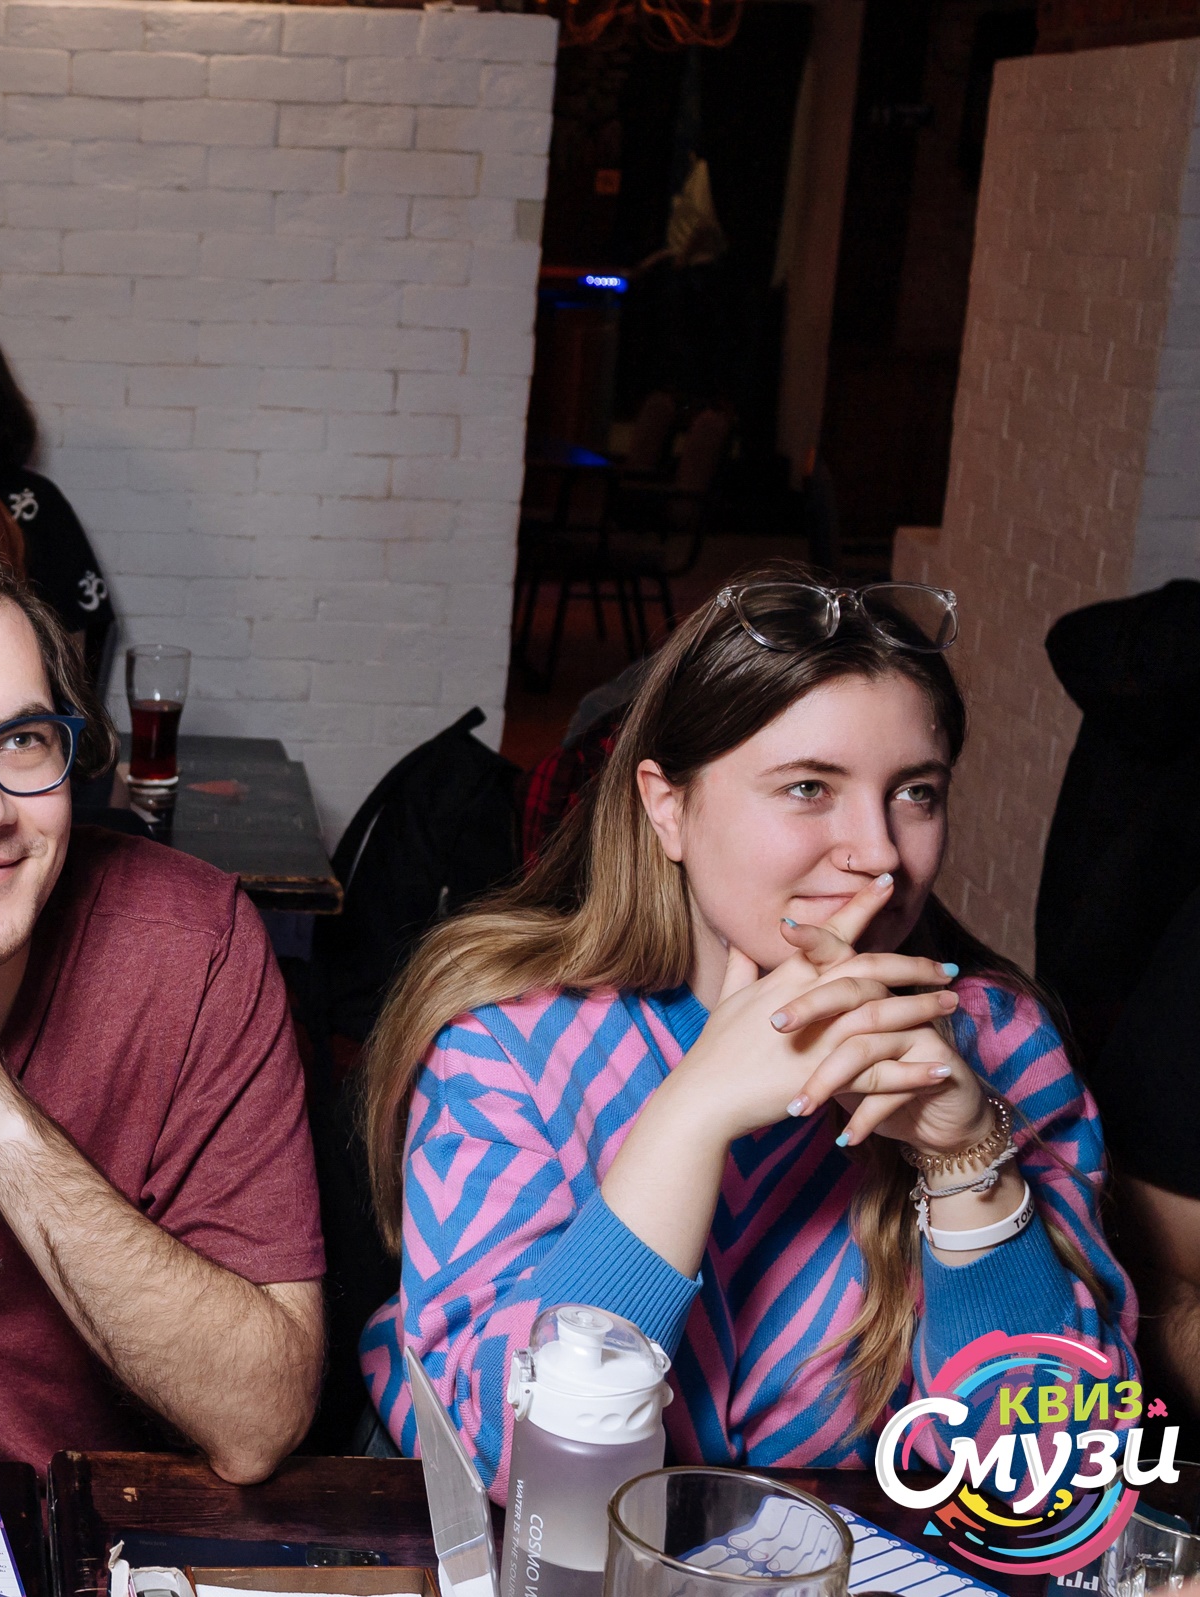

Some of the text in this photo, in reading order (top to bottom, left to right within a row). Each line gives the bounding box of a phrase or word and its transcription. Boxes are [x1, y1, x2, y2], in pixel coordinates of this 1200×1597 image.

[514, 1479, 524, 1520] WATER
[513, 1520, 520, 1534] IS
[511, 1536, 519, 1561] THE
[526, 1513, 544, 1582] COSMO
